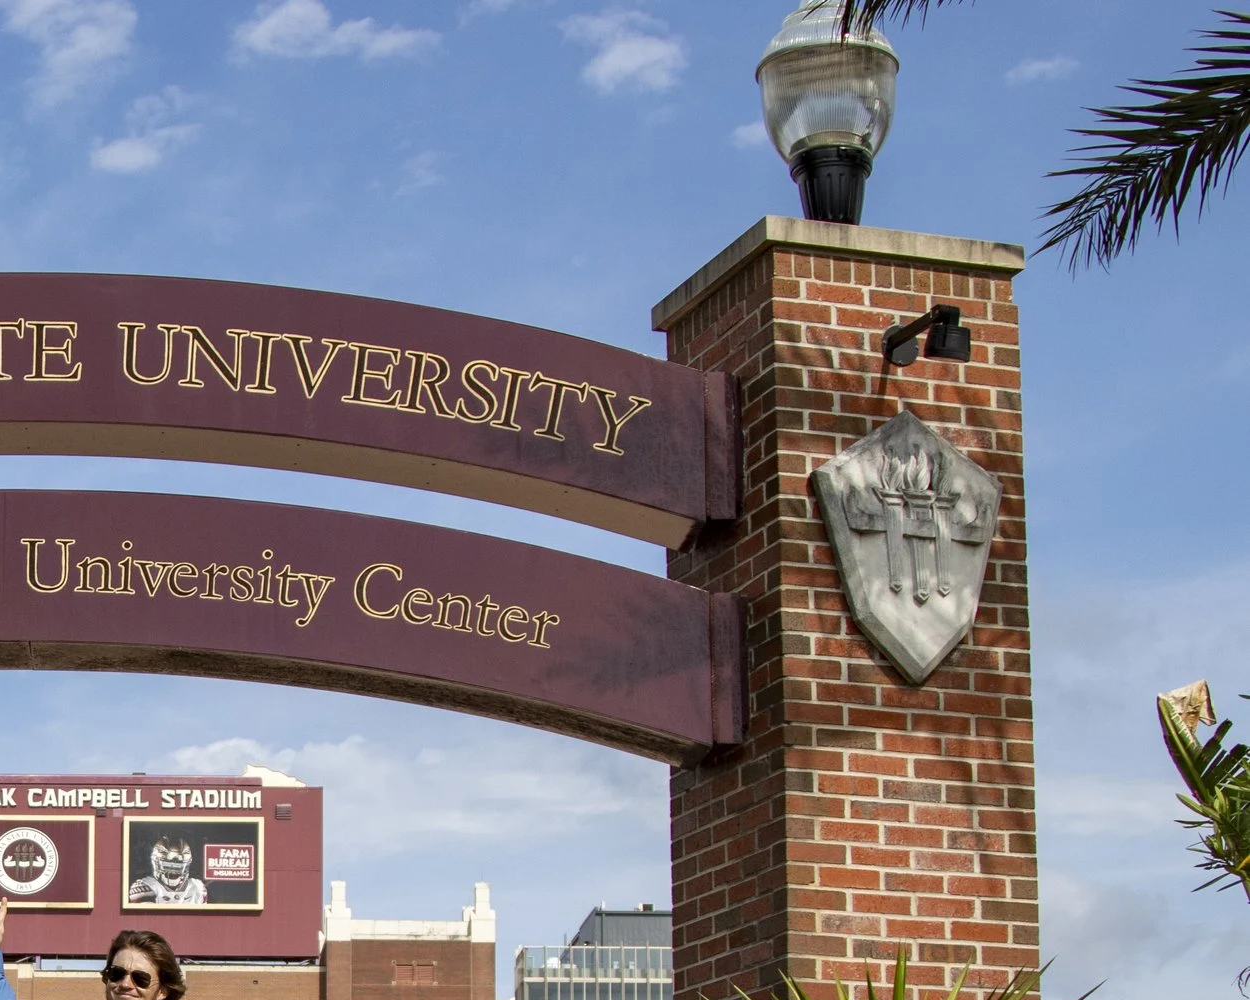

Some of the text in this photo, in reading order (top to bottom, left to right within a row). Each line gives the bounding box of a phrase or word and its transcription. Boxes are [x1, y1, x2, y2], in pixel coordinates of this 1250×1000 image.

[117, 322, 652, 455] UNIVERSITY
[21, 538, 336, 628] University
[354, 563, 561, 650] Center
[28, 788, 150, 808] CAMPBELL
[161, 789, 262, 809] STADIUM
[208, 858, 250, 868] BUREAU
[220, 848, 250, 859] FARM
